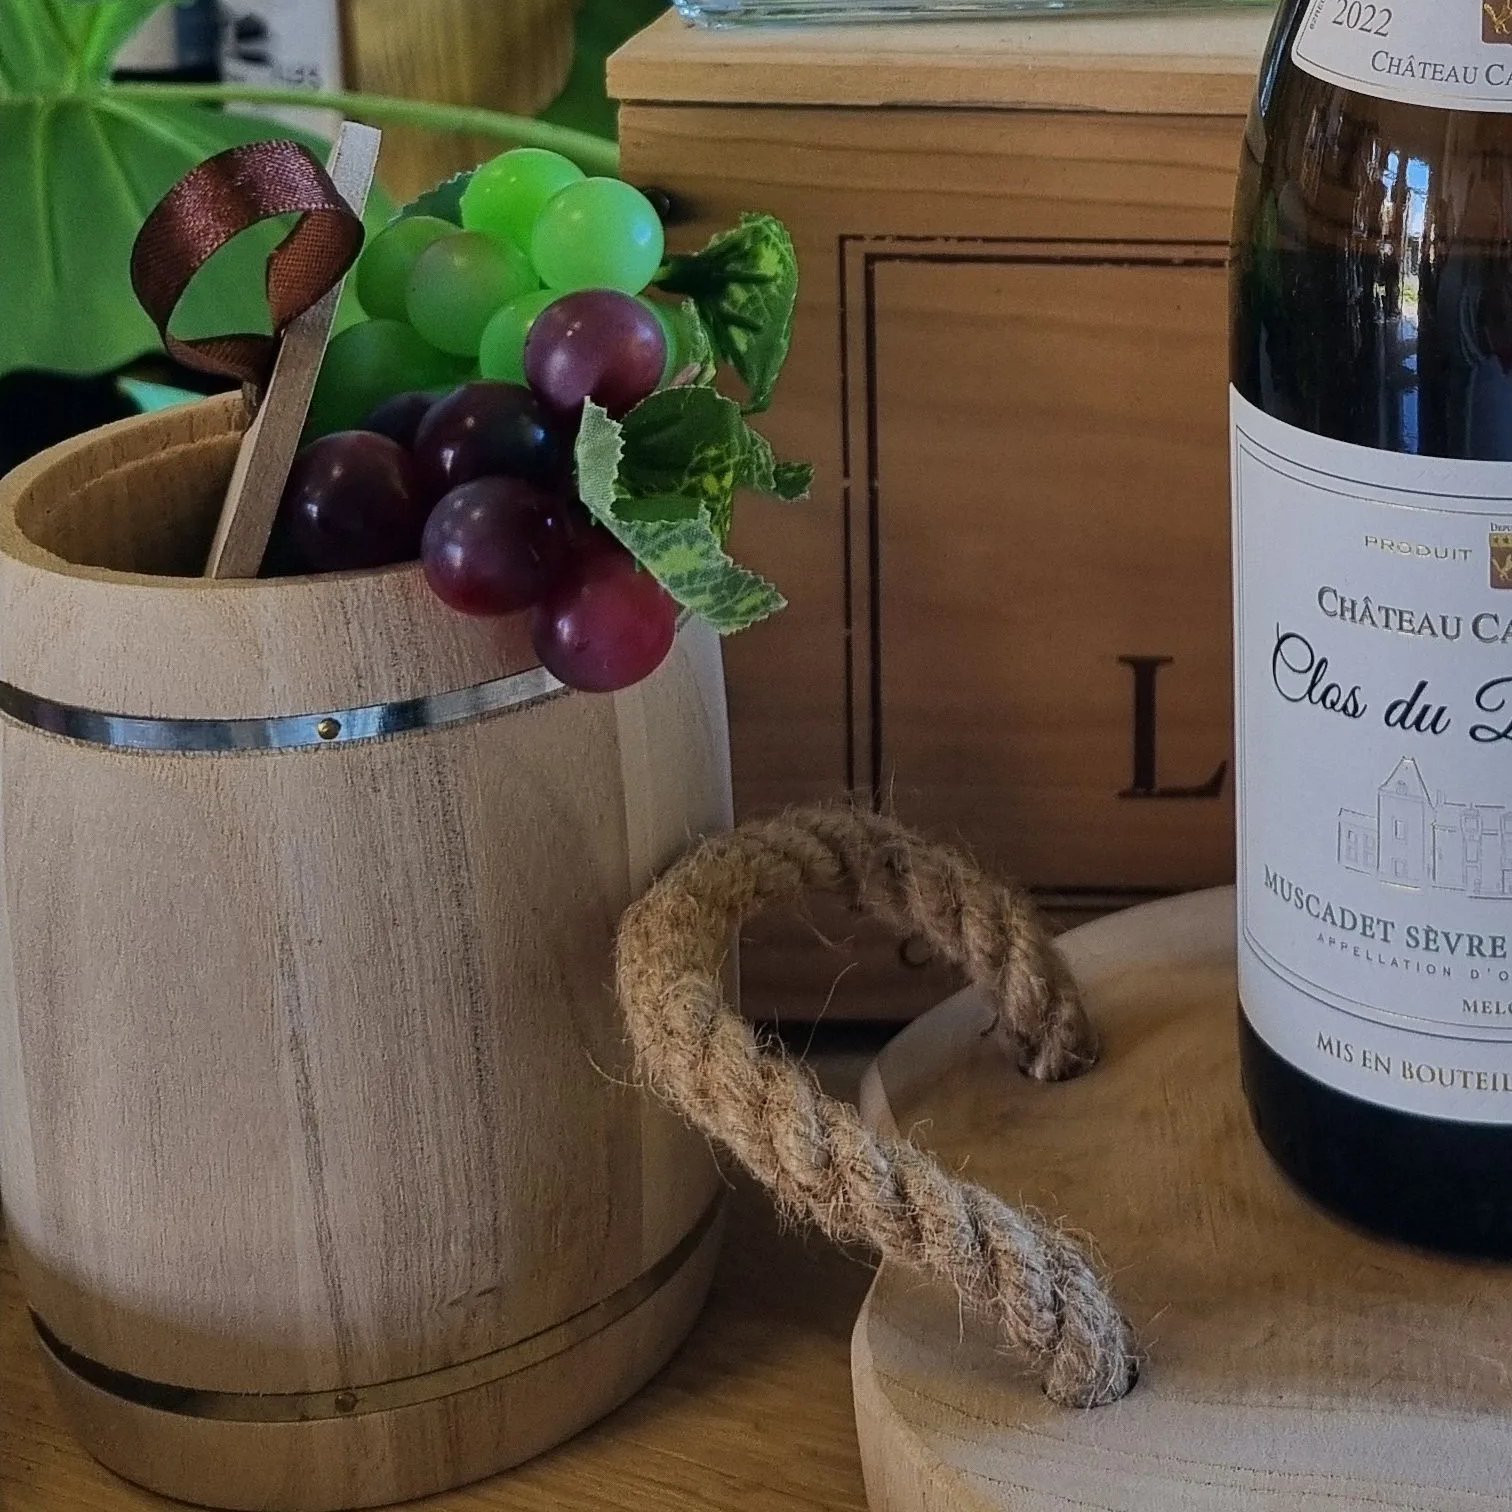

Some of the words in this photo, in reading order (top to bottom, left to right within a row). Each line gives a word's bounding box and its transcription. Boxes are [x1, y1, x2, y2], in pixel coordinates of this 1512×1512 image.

[1371, 49, 1477, 86] CHÂTEAU
[1365, 535, 1473, 561] PRODUIT
[1317, 586, 1461, 641] CHÂTEAU
[1272, 622, 1368, 719] Clos
[1384, 679, 1452, 735] du
[1263, 864, 1396, 944] MUSCADET
[1405, 925, 1507, 959] SÈVRE
[1316, 933, 1453, 978] APPELLATION
[1316, 1031, 1355, 1065] MIS
[1361, 1049, 1393, 1076] EN
